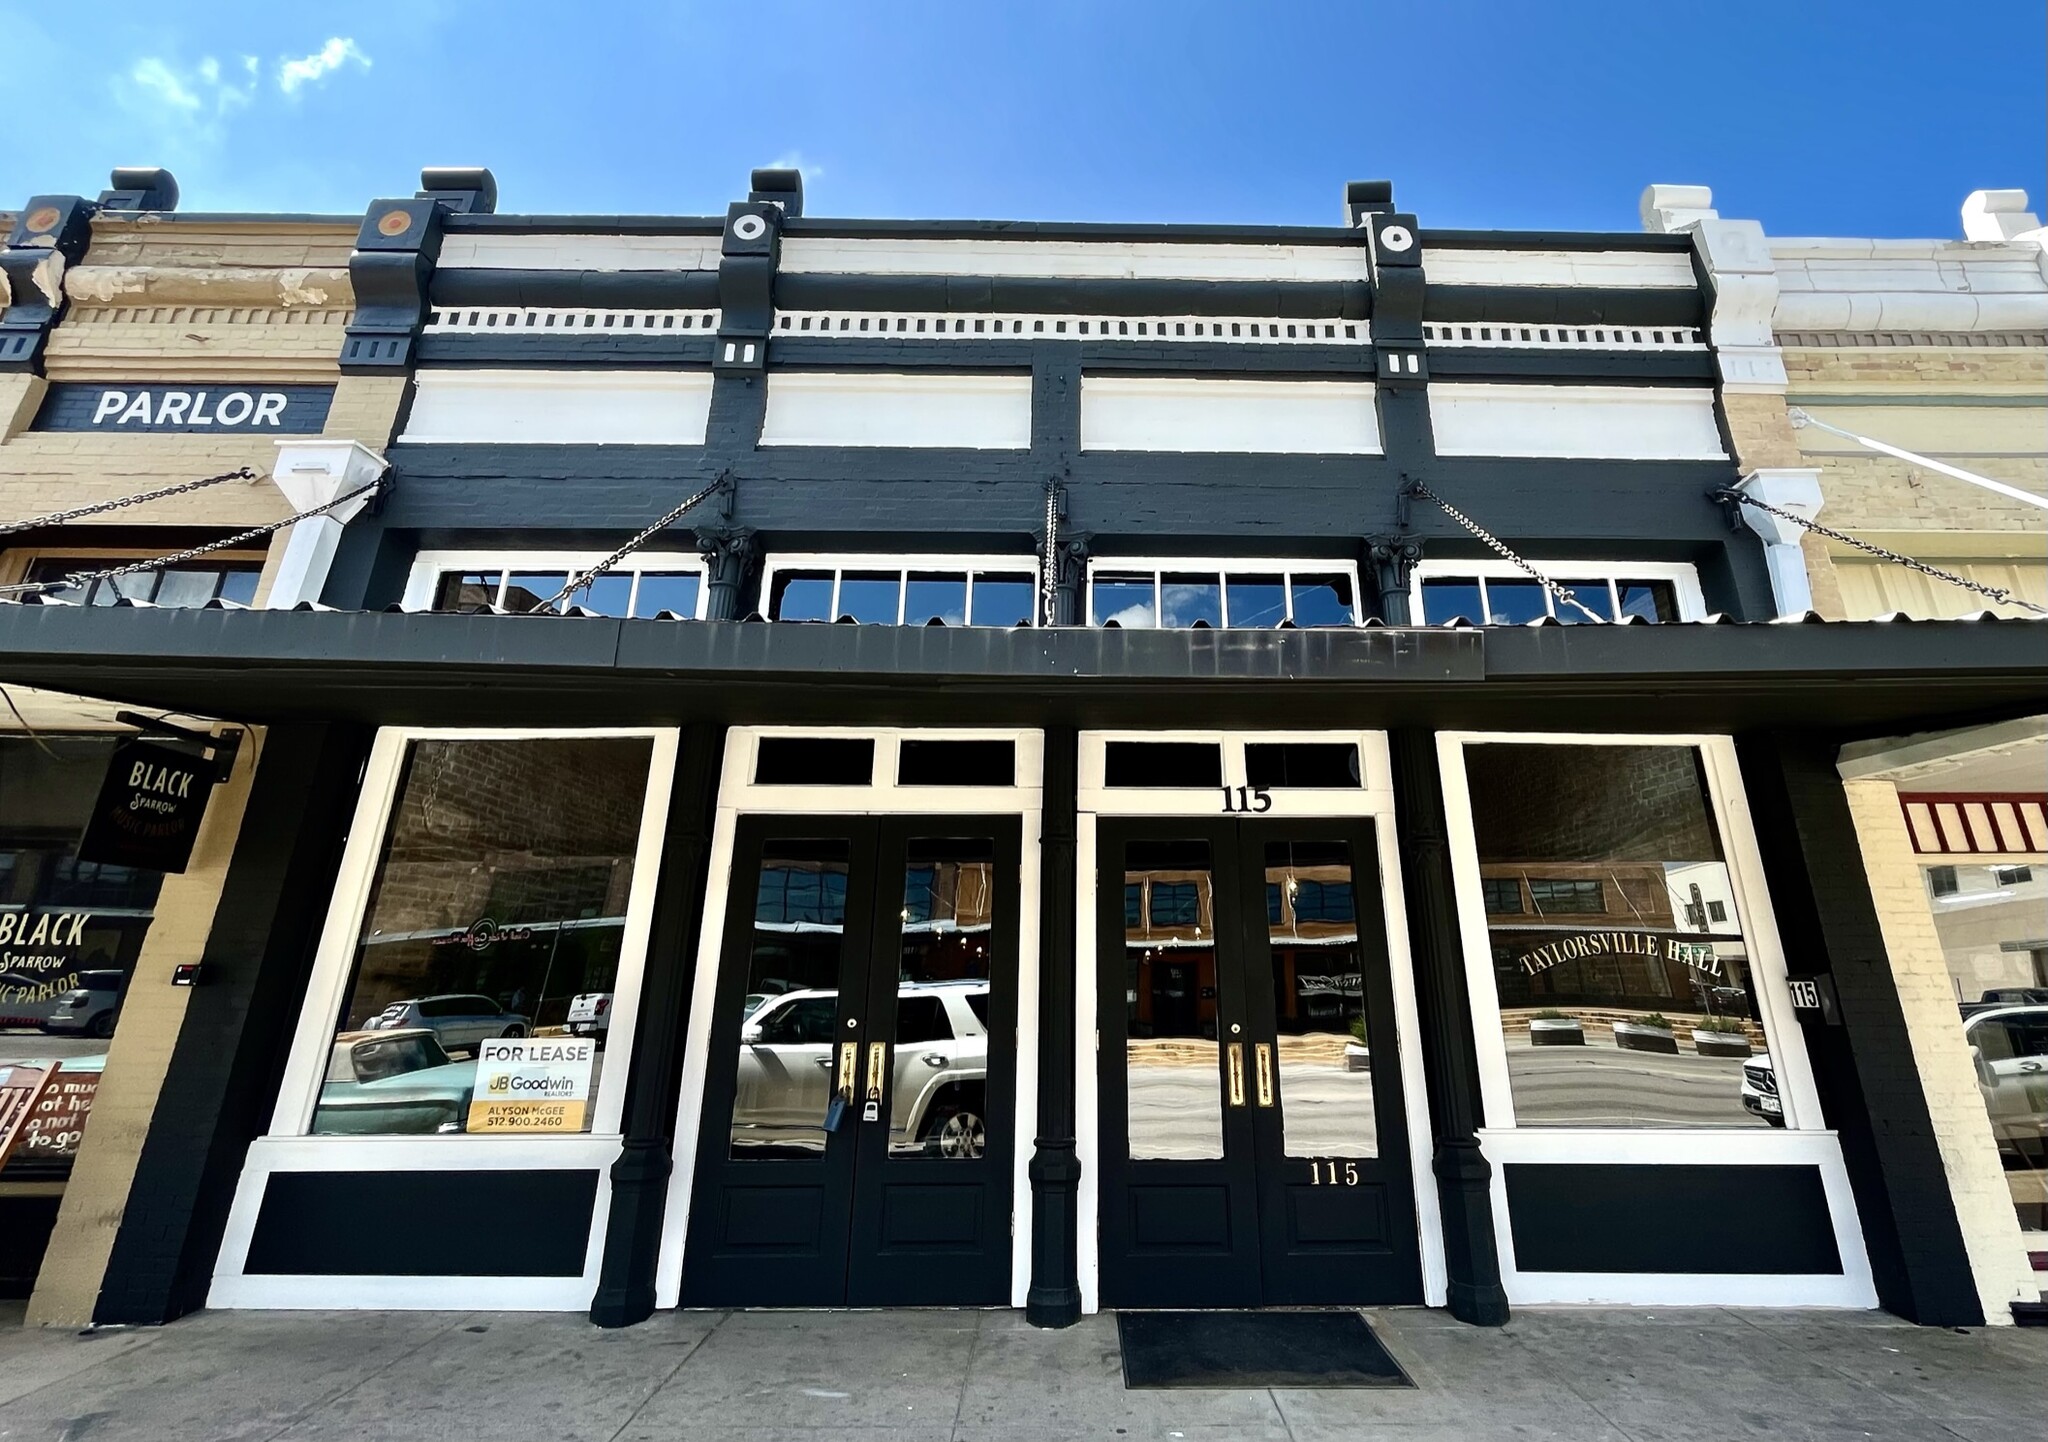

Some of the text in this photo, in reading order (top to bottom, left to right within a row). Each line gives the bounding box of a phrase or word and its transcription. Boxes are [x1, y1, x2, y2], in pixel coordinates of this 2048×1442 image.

[92, 391, 288, 426] PARLOR
[128, 761, 194, 798] BLACK
[130, 793, 177, 814] SPARROW
[1221, 784, 1272, 814] 115
[111, 805, 185, 837] MUSIC PARLOR
[0, 913, 91, 946] BLACK
[0, 951, 66, 973] SPARROW
[1518, 932, 1722, 977] TAYLORSVILLE HALL
[15, 973, 80, 1004] PARLOR
[1790, 981, 1817, 1008] 115
[485, 1046, 588, 1062] FOR LEASE
[488, 1075, 574, 1091] JB Goodwin
[46, 1113, 78, 1129] not
[487, 1106, 565, 1116] ALYSON McGEE
[487, 1116, 563, 1127] 512.900.2460
[28, 1130, 82, 1149] to go
[1310, 1161, 1359, 1187] 115
